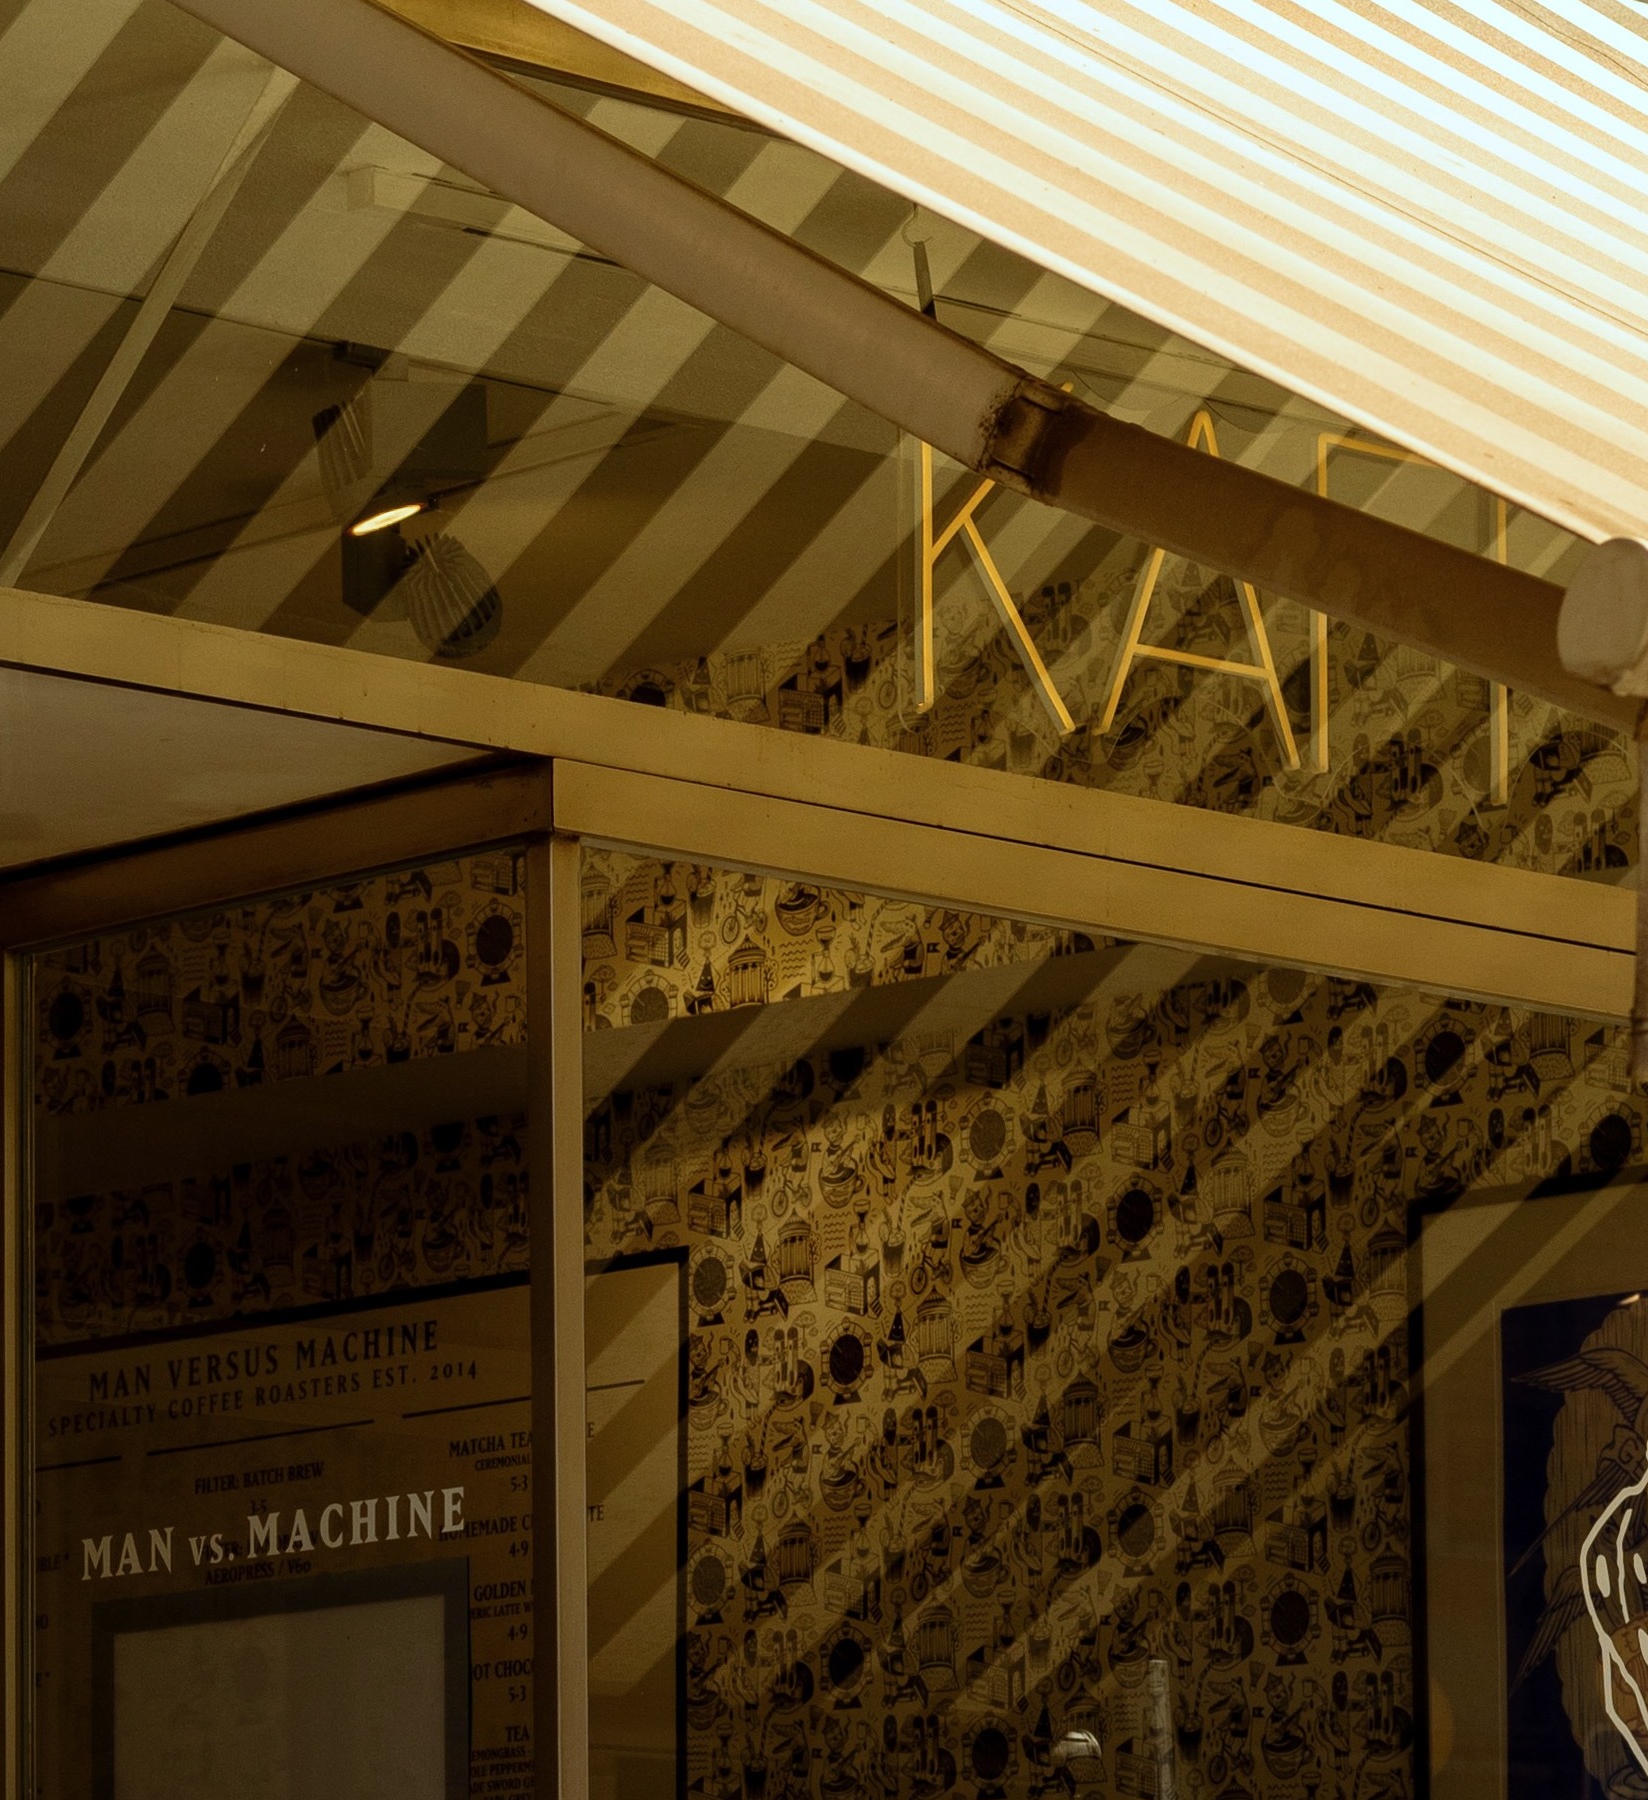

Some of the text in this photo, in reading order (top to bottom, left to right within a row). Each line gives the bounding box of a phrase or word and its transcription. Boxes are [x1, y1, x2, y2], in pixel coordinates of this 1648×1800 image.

[89, 1319, 439, 1402] MAN VERSUS MACHINE
[48, 1360, 477, 1438] SPECIALTY COFFEE ROASTERS EST. 2014
[448, 1435, 505, 1457] MATCHA
[194, 1461, 325, 1495] FILTER: BATCH BREW
[81, 1526, 175, 1581] MAN
[247, 1486, 465, 1559] MACHINE
[204, 1561, 275, 1586] AEROPRESS
[473, 1580, 527, 1602] GOLDEN
[494, 1658, 534, 1679] CHOC
[505, 1725, 531, 1743] TEA
